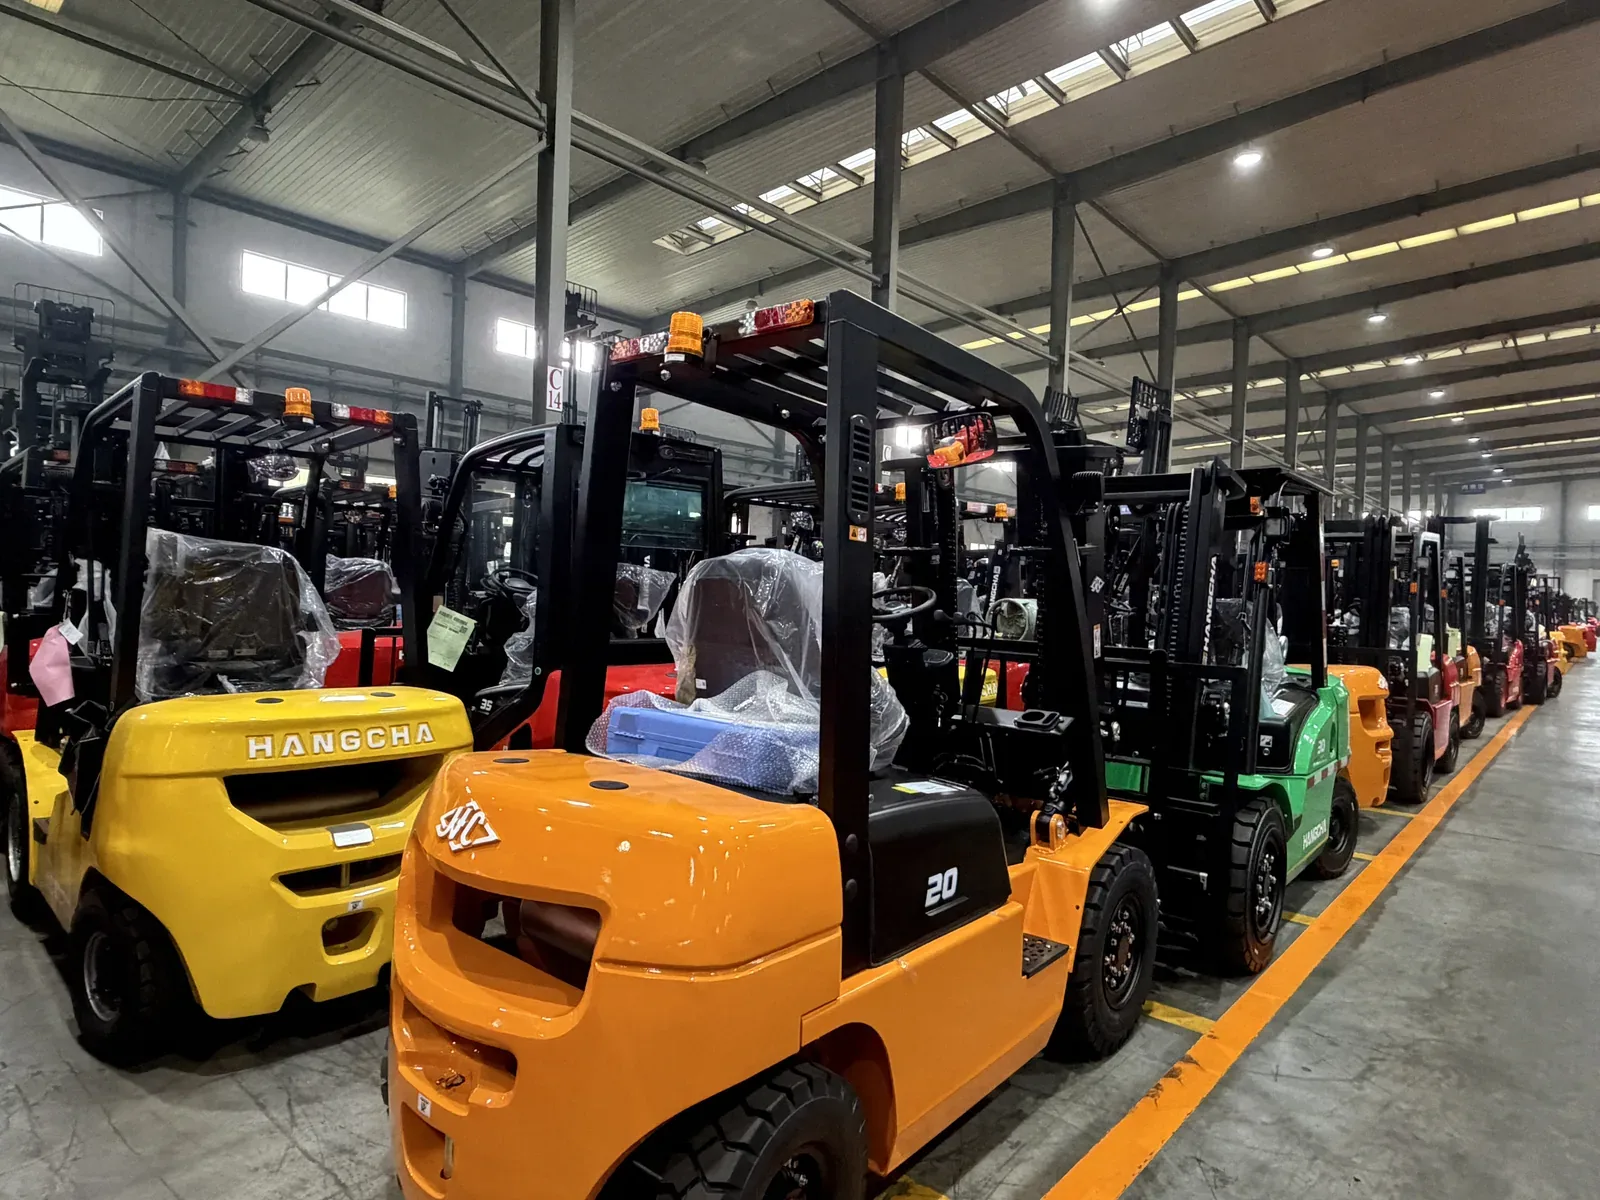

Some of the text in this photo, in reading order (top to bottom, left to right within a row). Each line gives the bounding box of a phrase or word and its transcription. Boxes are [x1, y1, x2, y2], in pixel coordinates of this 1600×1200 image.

[549, 368, 562, 390] C
[548, 390, 562, 410] 14
[1202, 554, 1217, 652] HANGCHA
[480, 698, 493, 711] 35
[247, 722, 435, 760] HANGCHA
[924, 866, 959, 908] 20
